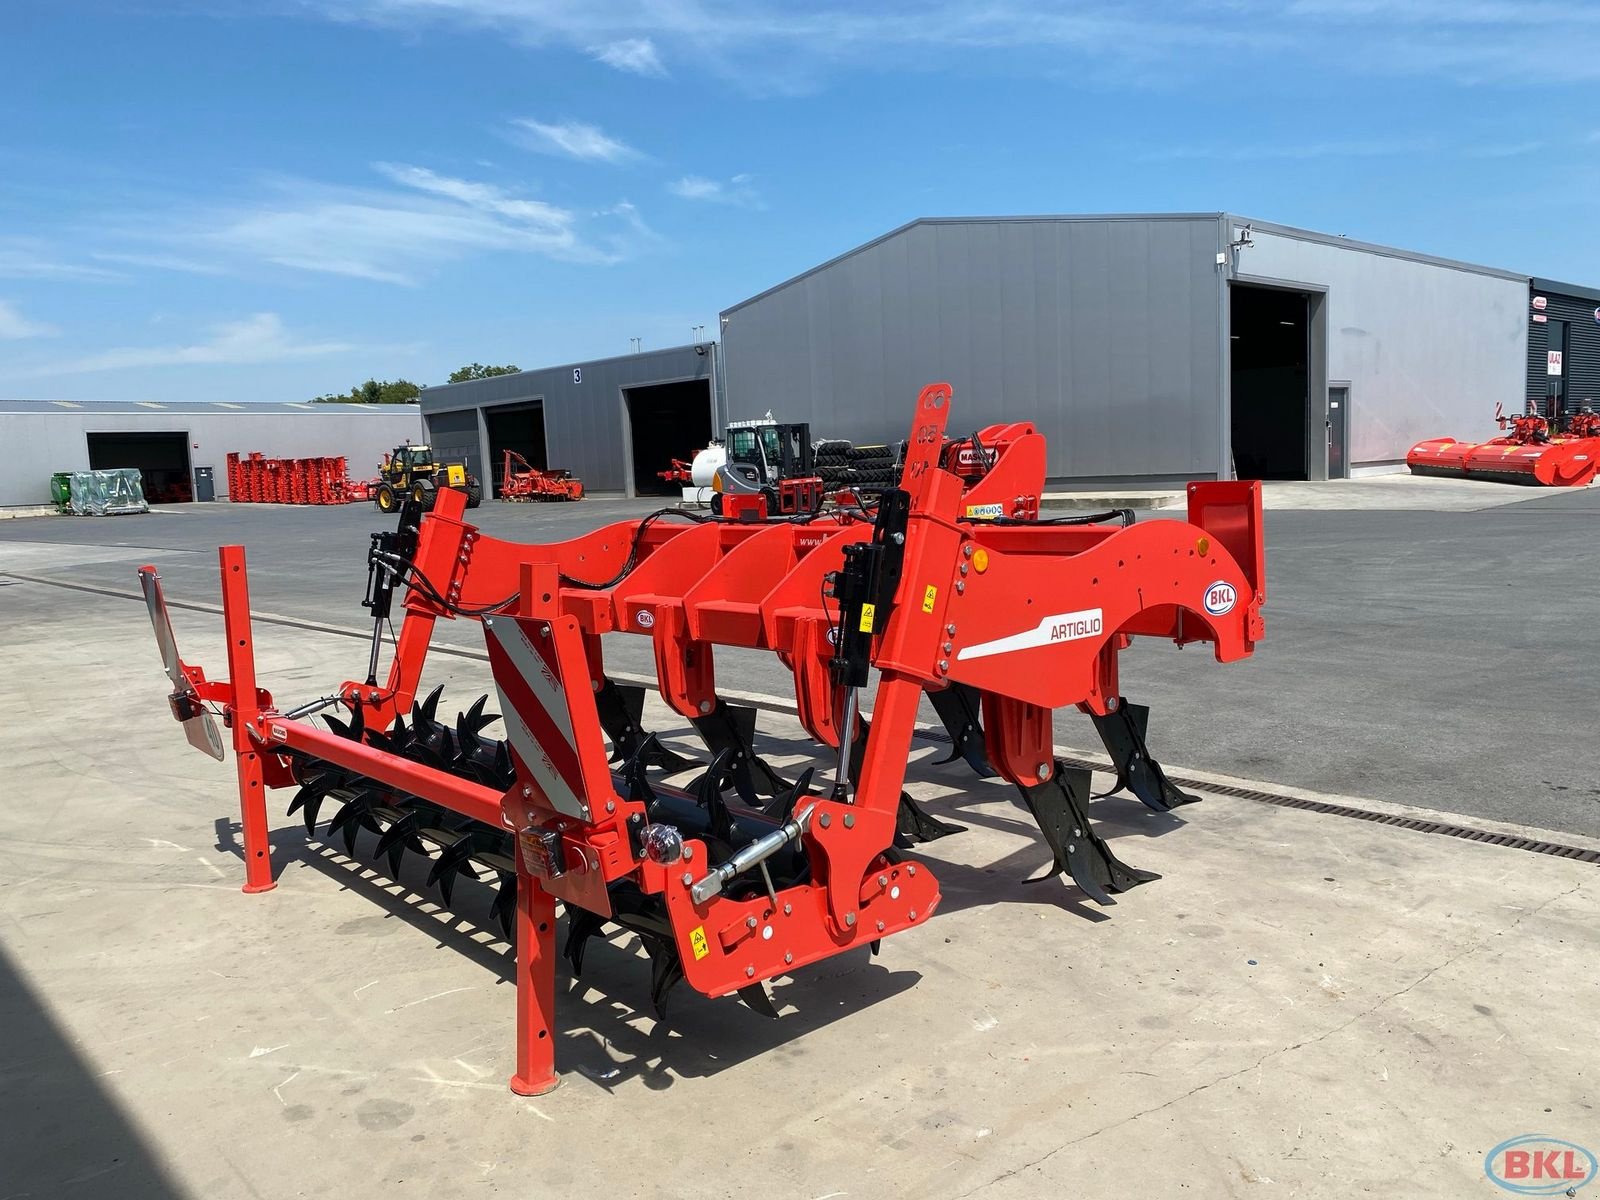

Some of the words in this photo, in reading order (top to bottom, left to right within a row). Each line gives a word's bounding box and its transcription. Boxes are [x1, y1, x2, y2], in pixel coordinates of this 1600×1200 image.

[574, 369, 581, 383] 3
[1210, 588, 1232, 606] BKL
[640, 614, 652, 623] BKL
[1050, 618, 1101, 641] ARTIGLIO
